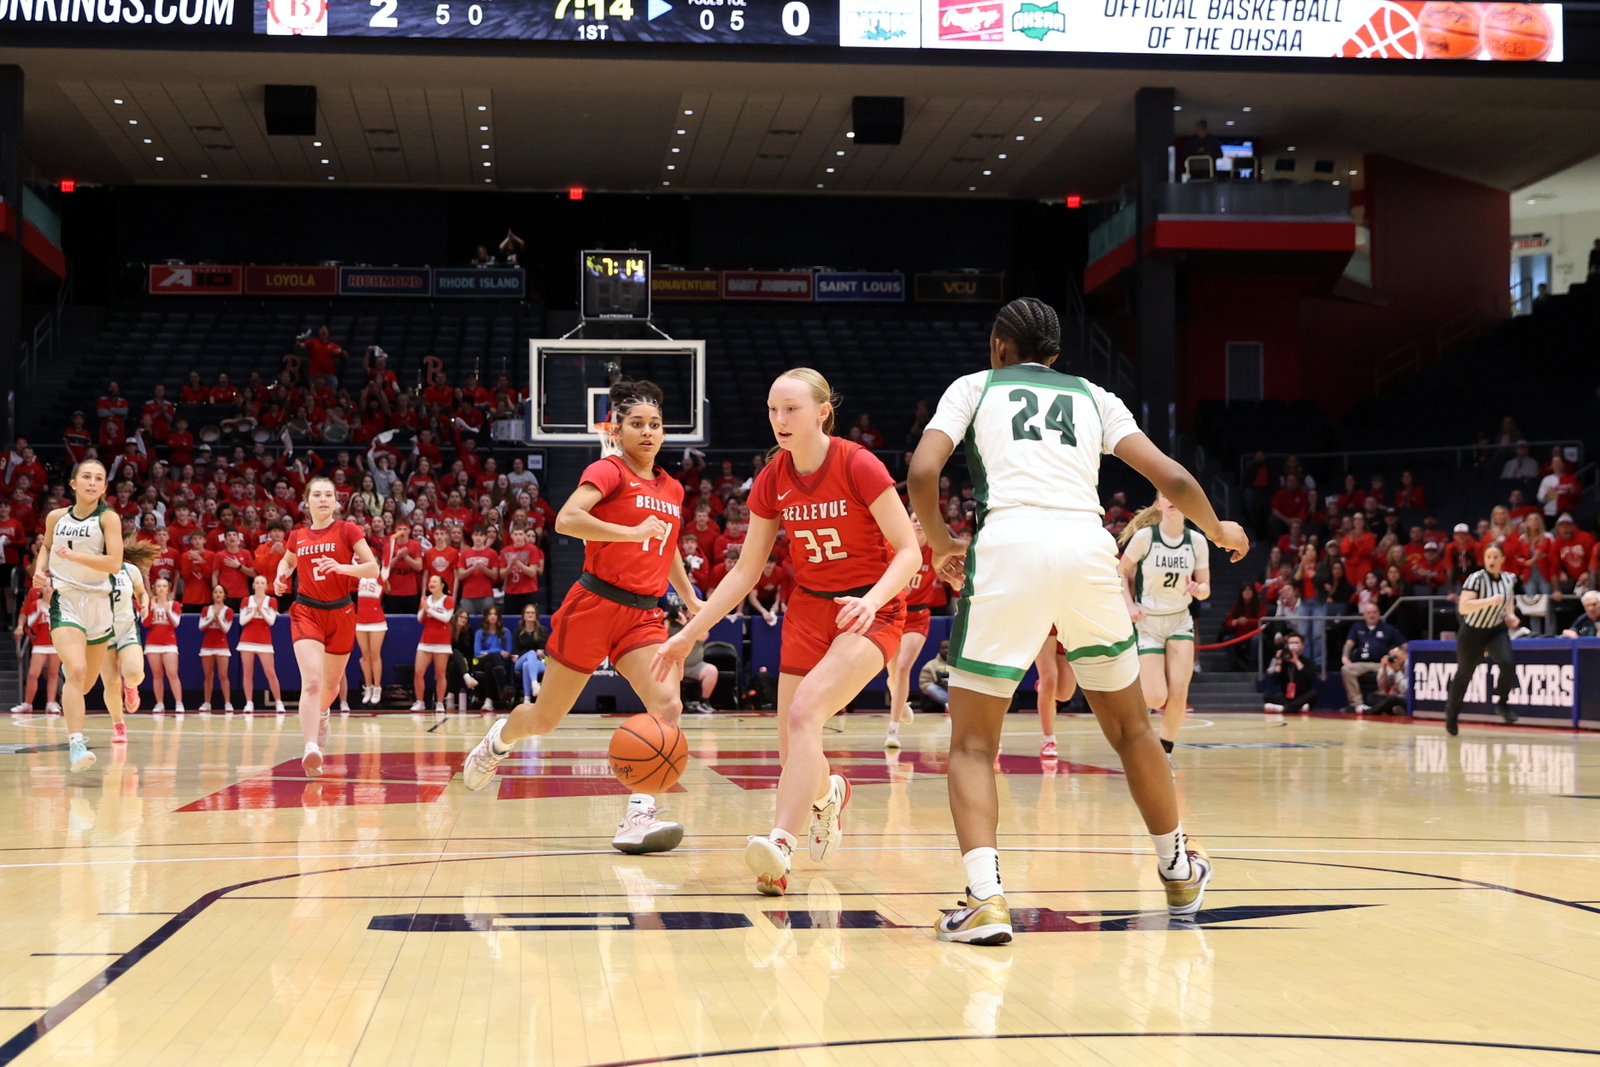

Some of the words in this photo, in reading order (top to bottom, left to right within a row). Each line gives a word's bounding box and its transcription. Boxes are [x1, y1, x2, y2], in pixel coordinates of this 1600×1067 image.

[369, 0, 398, 27] 2
[436, 4, 450, 25] 5
[468, 4, 482, 26] 0
[782, 1, 810, 36] 0
[1104, 0, 1197, 19] OFFICIAL
[1207, 0, 1343, 22] BASKETBALL
[700, 9, 714, 30] 0
[730, 10, 744, 31] 5
[578, 25, 609, 40] 1ST
[1147, 27, 1175, 49] OF
[1184, 27, 1223, 50] THE
[1230, 28, 1302, 51] OHSAA
[602, 257, 645, 276] 7:14
[266, 274, 315, 286] LOYOLA
[348, 275, 422, 289] RICHMOND
[439, 277, 475, 288] RHODE
[480, 277, 519, 289] ISLAND
[652, 279, 717, 291] BONAVENTURE
[819, 281, 857, 292] SAINT
[862, 281, 901, 293] LOUIS
[943, 281, 977, 294] VCU
[1009, 389, 1077, 447] 24
[782, 499, 848, 521] BELLEVUE
[56, 523, 90, 537] LAUREL
[297, 542, 336, 557] BELLEVUE
[794, 528, 848, 563] 32
[311, 557, 326, 581] 2
[1155, 555, 1188, 569] LAUREL
[1163, 572, 1180, 588] 21
